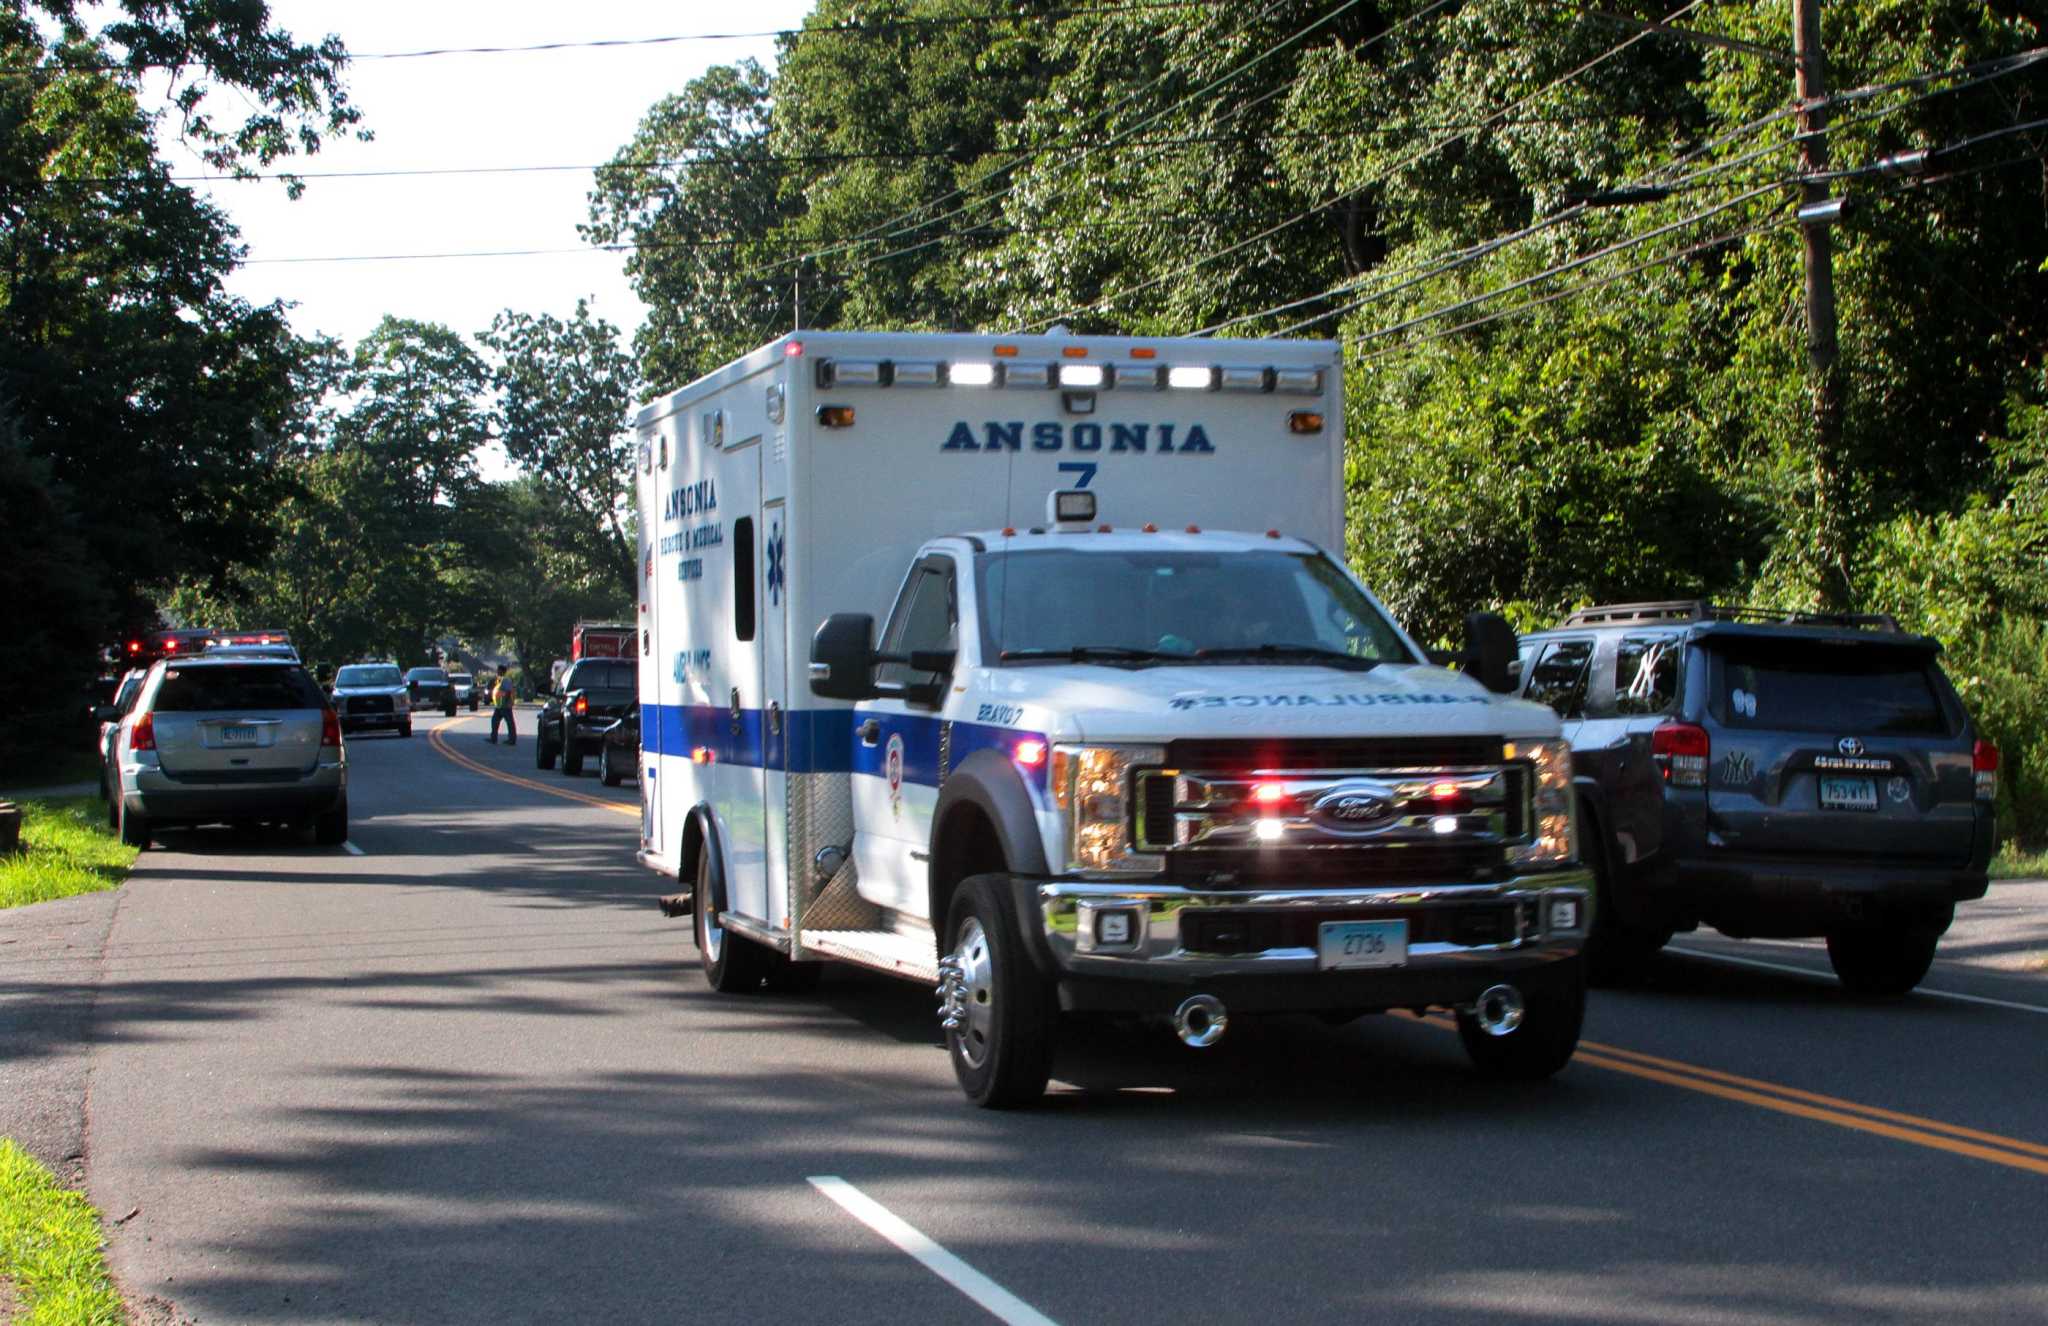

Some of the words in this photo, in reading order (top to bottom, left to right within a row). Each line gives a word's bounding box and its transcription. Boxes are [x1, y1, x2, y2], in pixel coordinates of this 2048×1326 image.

[941, 421, 1215, 452] ANSONIA
[1058, 462, 1097, 488] 7
[664, 478, 717, 521] ANSONIA
[692, 522, 723, 549] MEDICAL
[977, 704, 1013, 725] BRAVO
[1013, 708, 1024, 725] 7
[1335, 797, 1384, 818] Ford
[1343, 934, 1386, 956] 2736
